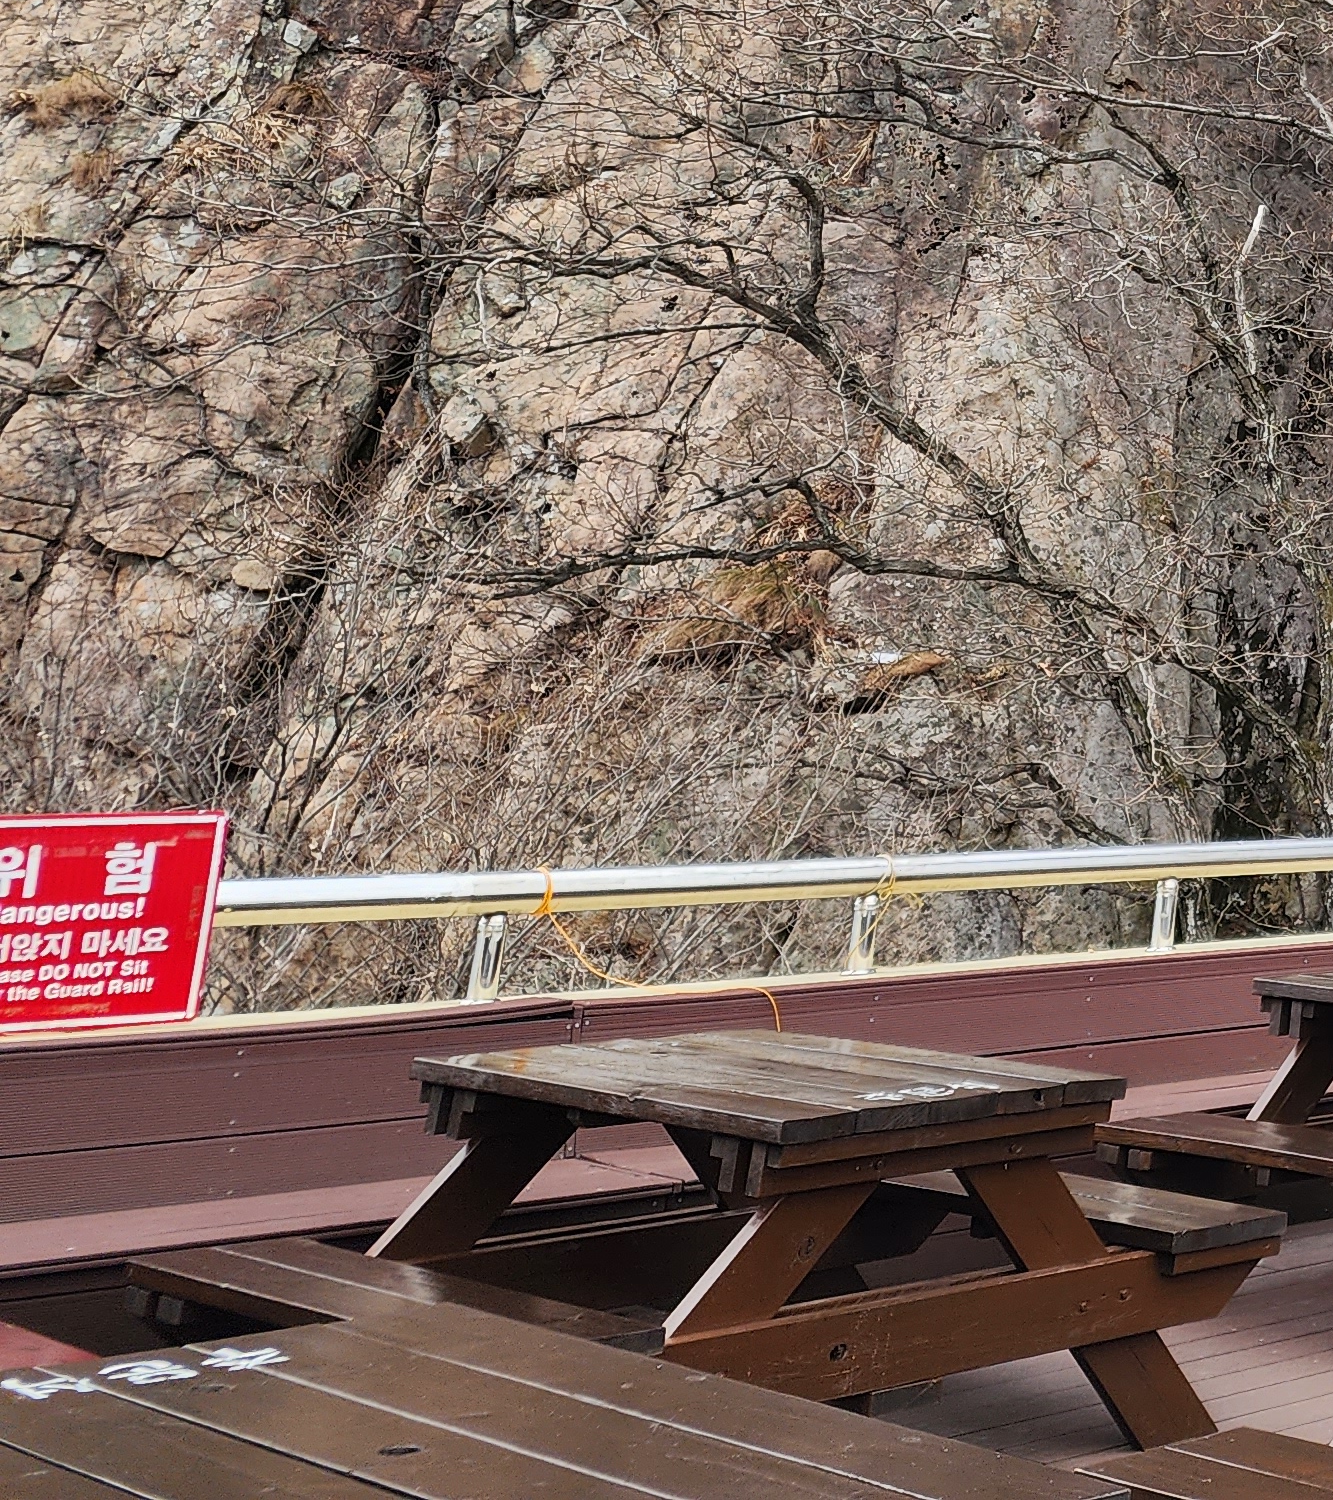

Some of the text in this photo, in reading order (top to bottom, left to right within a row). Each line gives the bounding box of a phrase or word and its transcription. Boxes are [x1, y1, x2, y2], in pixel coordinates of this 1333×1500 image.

[0, 897, 146, 925] angerous!
[0, 927, 169, 963] 앉지 마세요
[38, 964, 70, 981] DO
[73, 961, 118, 980] NOT
[120, 960, 149, 976] Sit
[7, 985, 41, 1002] the
[44, 980, 103, 999] Guard
[107, 977, 154, 994] Rail!
